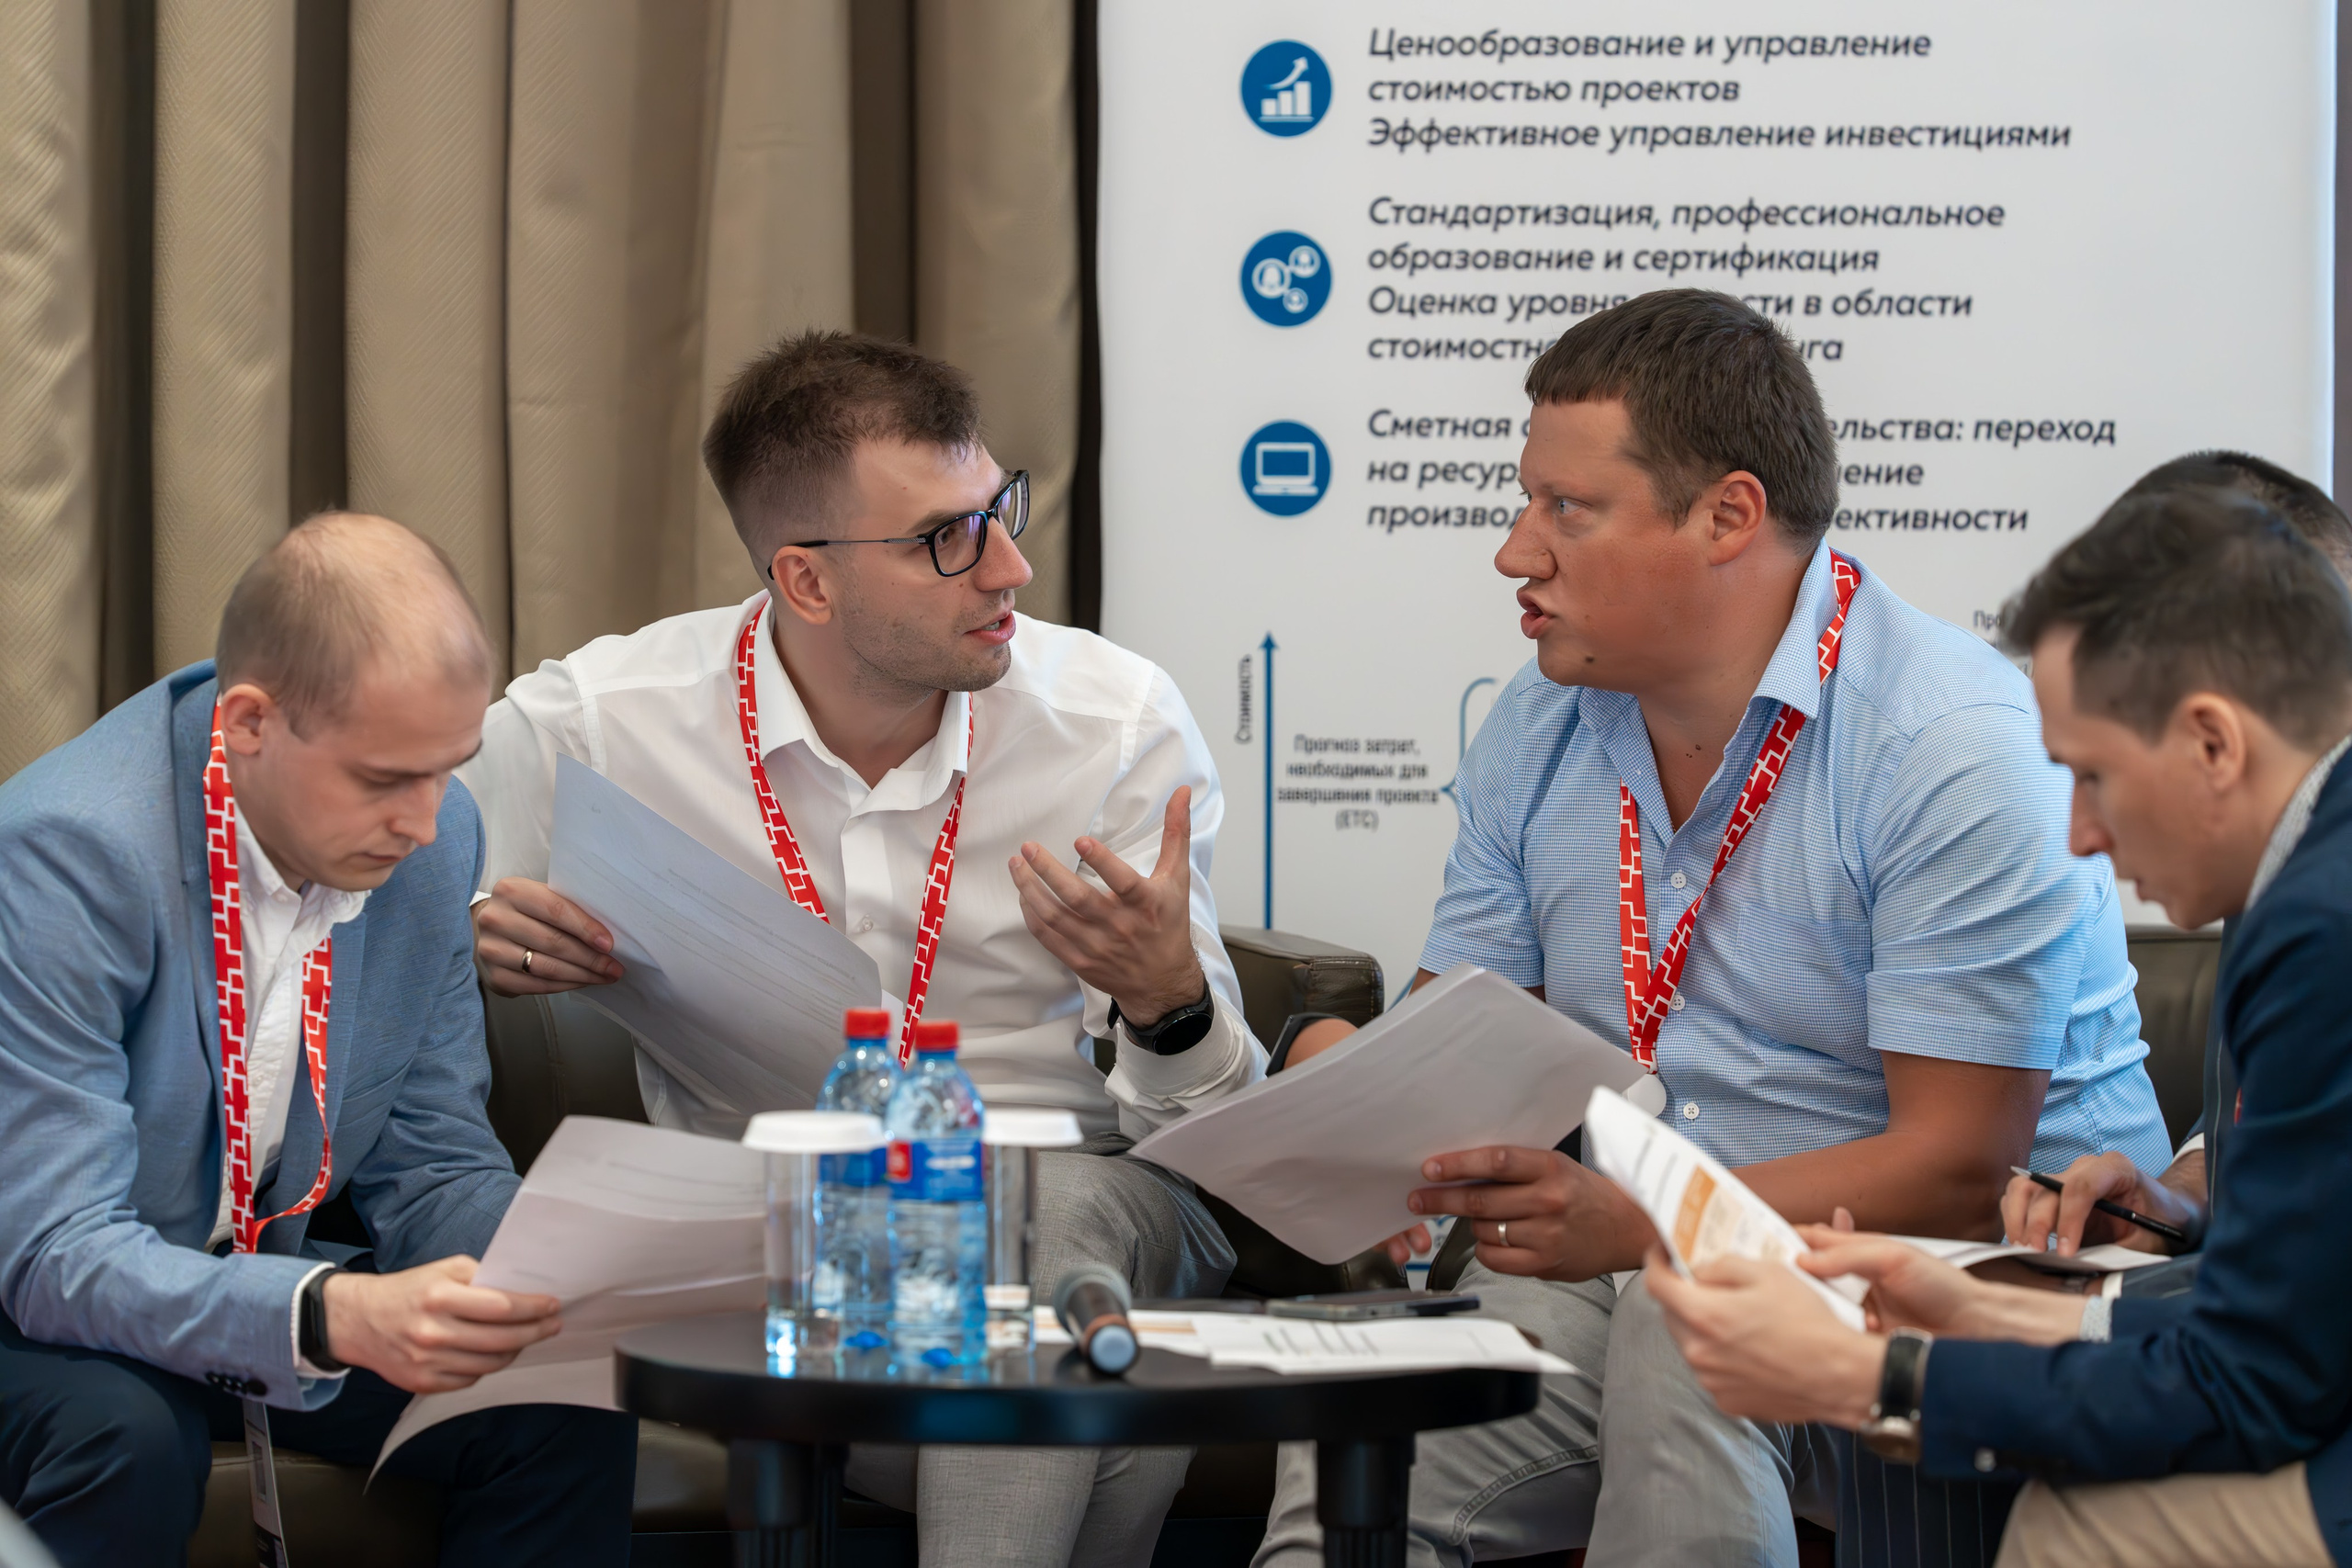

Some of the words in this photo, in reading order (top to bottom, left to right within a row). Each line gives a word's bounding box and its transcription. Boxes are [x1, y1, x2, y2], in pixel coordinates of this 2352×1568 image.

[1368, 27, 1686, 64] Ценообразование
[1693, 35, 1715, 57] и
[1722, 34, 1933, 65] управление
[1367, 79, 1573, 103] стоимостью
[1579, 80, 1741, 110] проектов
[1367, 116, 1601, 154] Эффективное
[1606, 125, 1816, 155] управление
[1824, 125, 2072, 152] инвестициями
[1368, 196, 1661, 233] Стандартизация,
[1670, 197, 2007, 234] профессиональное
[1367, 241, 1596, 278] образование
[1602, 249, 1625, 272] и
[1632, 241, 1881, 279] сертификация
[1367, 285, 1498, 320] Оценка
[1802, 294, 1823, 317] в
[1830, 287, 1973, 318] области
[1367, 408, 1513, 439] Сметная
[1972, 419, 2117, 450] переход
[1366, 460, 1410, 483] на
[1417, 461, 1520, 492] ресур
[1835, 508, 2030, 532] ективности
